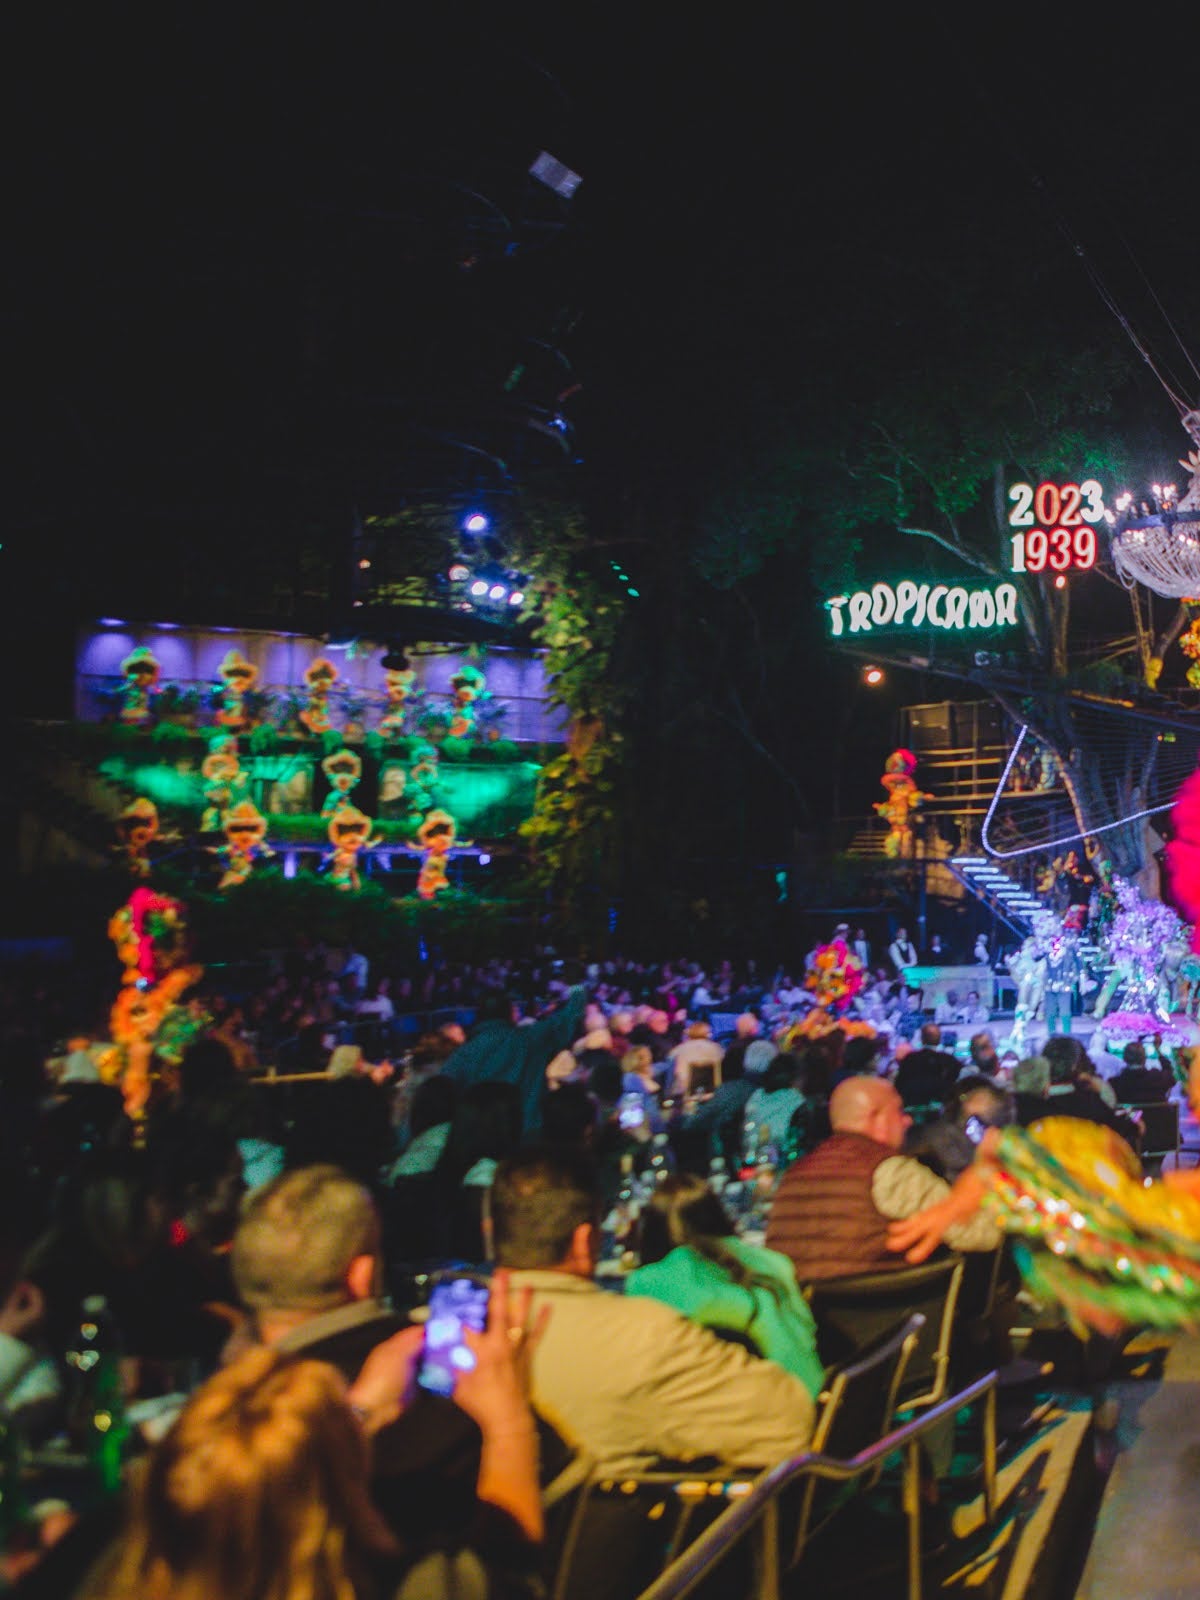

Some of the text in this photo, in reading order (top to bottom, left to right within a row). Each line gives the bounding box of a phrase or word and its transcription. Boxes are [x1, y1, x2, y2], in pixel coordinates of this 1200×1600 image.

[1009, 480, 1104, 526] 2023
[1010, 527, 1097, 573] 1939
[824, 580, 1018, 636] TROPICANA
